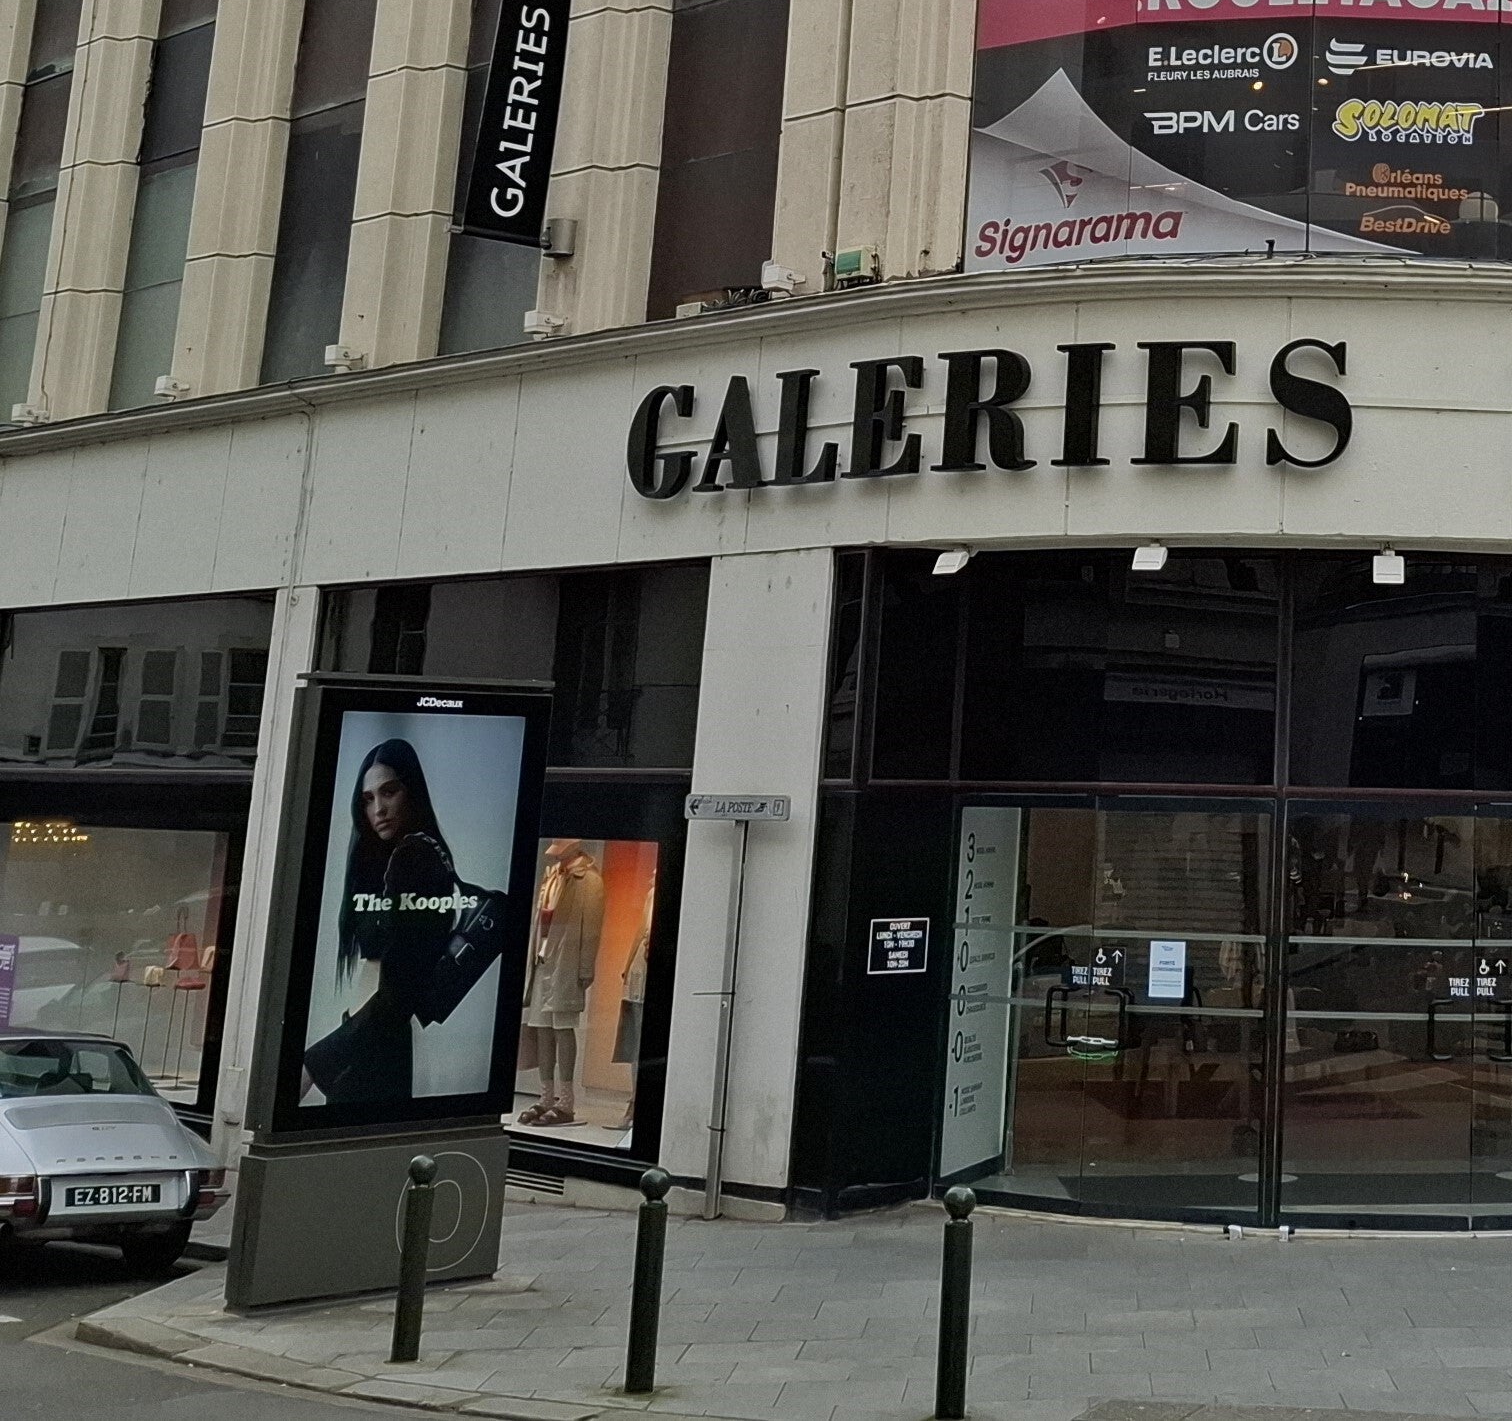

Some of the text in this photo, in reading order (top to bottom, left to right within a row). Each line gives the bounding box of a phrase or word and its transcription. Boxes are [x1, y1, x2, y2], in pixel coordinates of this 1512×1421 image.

[1148, 45, 1261, 67] E.Leclerc
[1376, 50, 1493, 69] EUROVIA
[1148, 68, 1260, 81] FLEURY LES AUBRAIS
[490, 4, 550, 218] GALERIES
[1332, 99, 1484, 141] SOLOMAT
[1143, 109, 1300, 135] BPM Cars
[1369, 132, 1473, 145] LOCATION
[1345, 182, 1468, 202] Pneumatiques
[1360, 215, 1451, 235] BestDrive
[974, 210, 1184, 264] Signarama
[626, 339, 1354, 500] GALERIES
[417, 697, 463, 708] JCDecaux
[715, 802, 754, 813] LA POSTE
[967, 833, 975, 863] 3
[965, 869, 973, 899] 2
[353, 893, 478, 913] The Kooples
[1448, 978, 1469, 986] TIREZ
[1451, 988, 1469, 996] PULL
[1477, 978, 1497, 986] TIREZ
[1477, 988, 1494, 996] PULL
